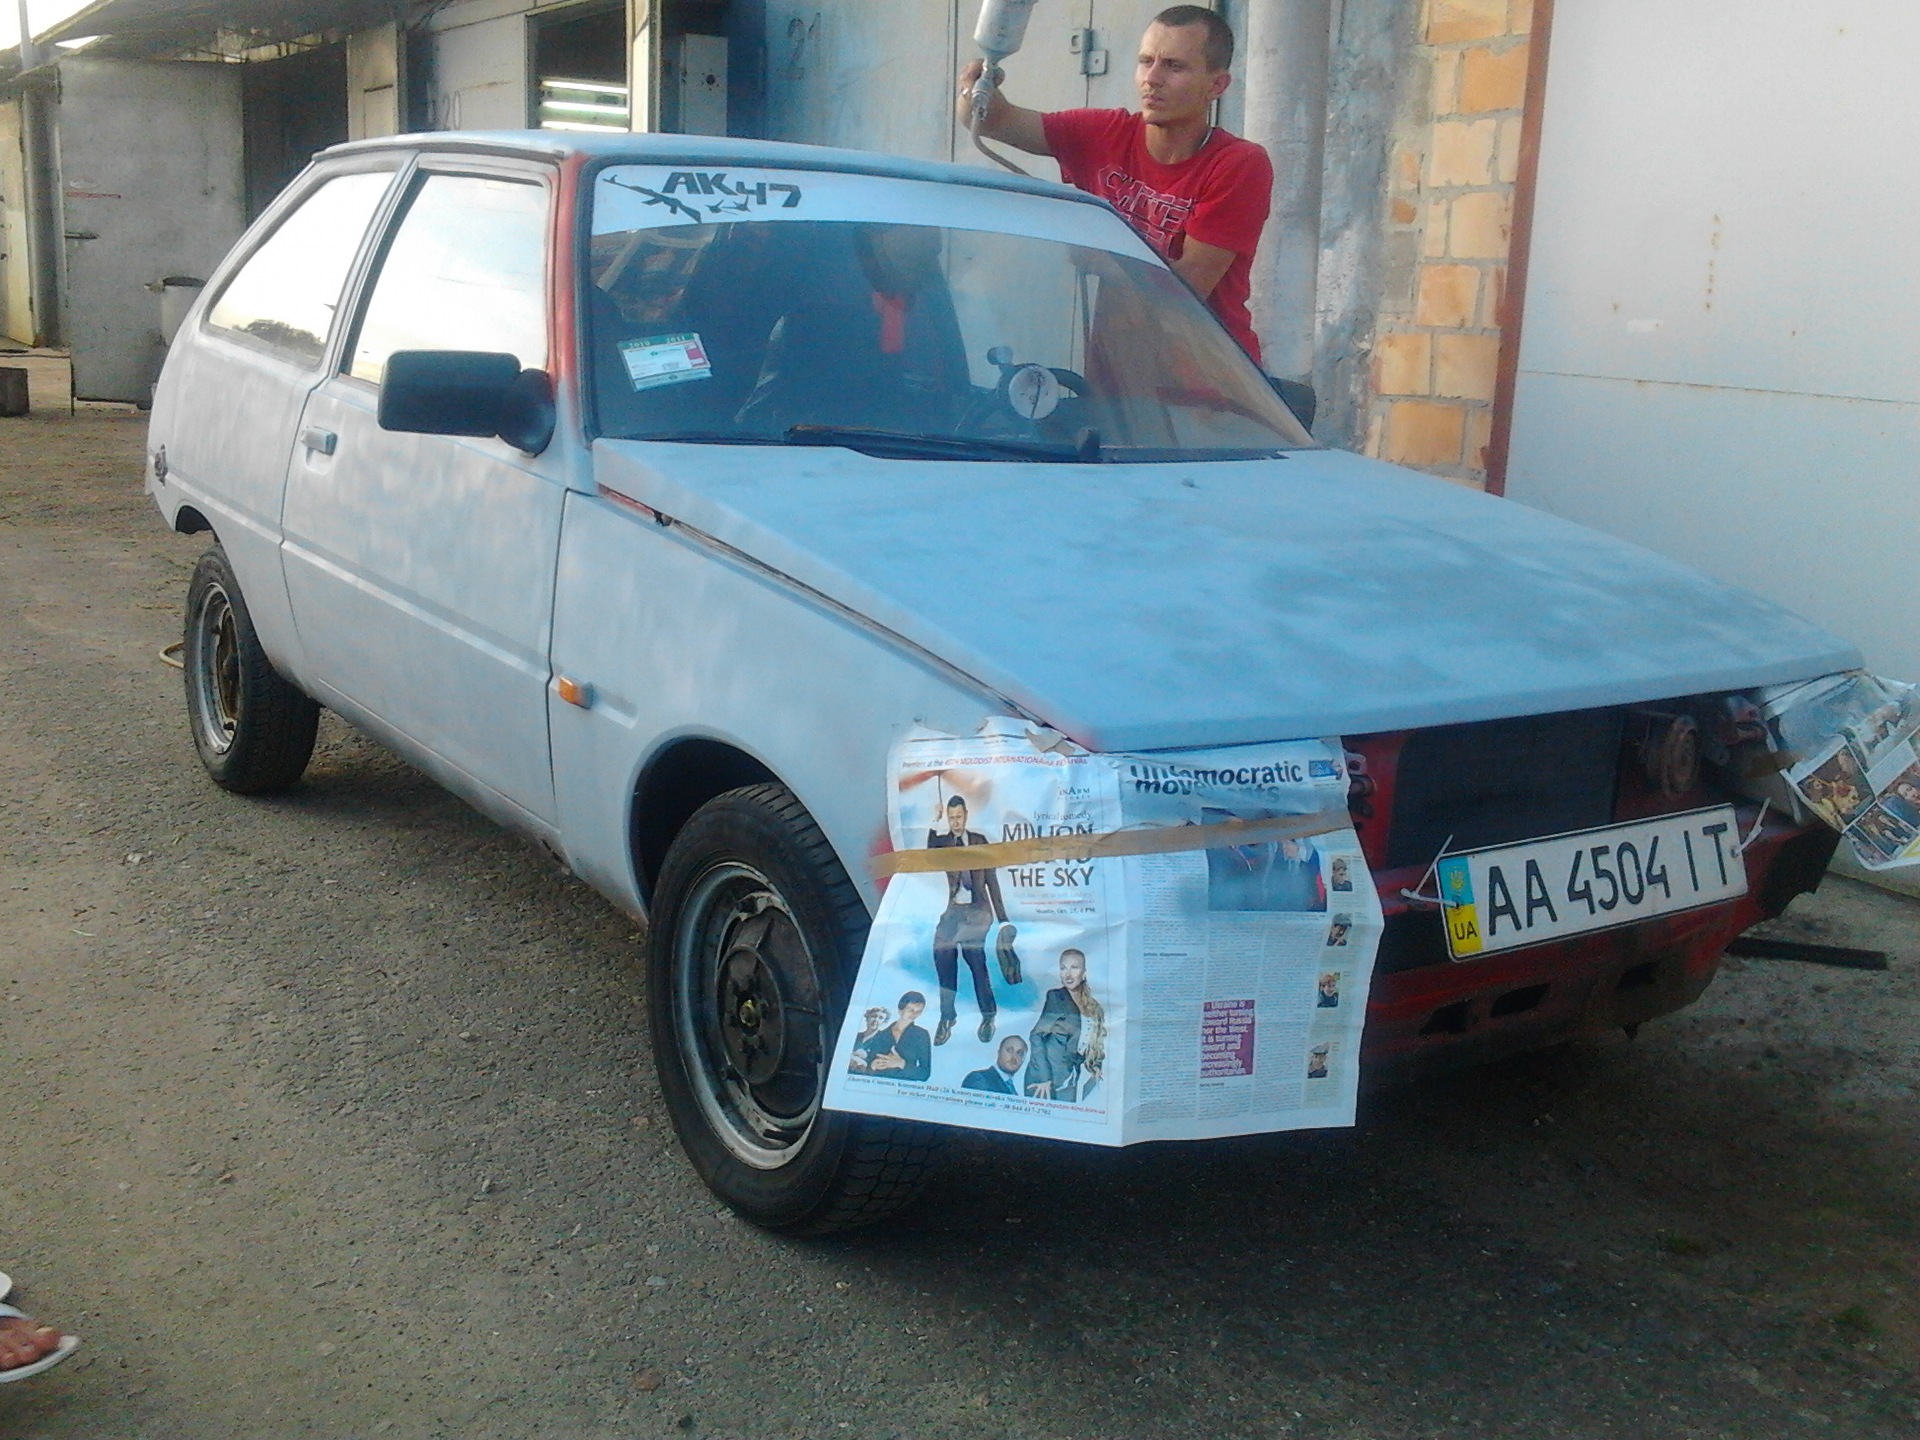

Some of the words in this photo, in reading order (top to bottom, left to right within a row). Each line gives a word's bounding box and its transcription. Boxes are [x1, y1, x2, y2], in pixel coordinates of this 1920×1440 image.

[1008, 868, 1045, 887] THE
[1053, 866, 1094, 887] SKY
[1489, 859, 1559, 936] AA
[1566, 835, 1671, 915] 4504
[1684, 822, 1729, 893] IT
[1453, 921, 1478, 941] UA
